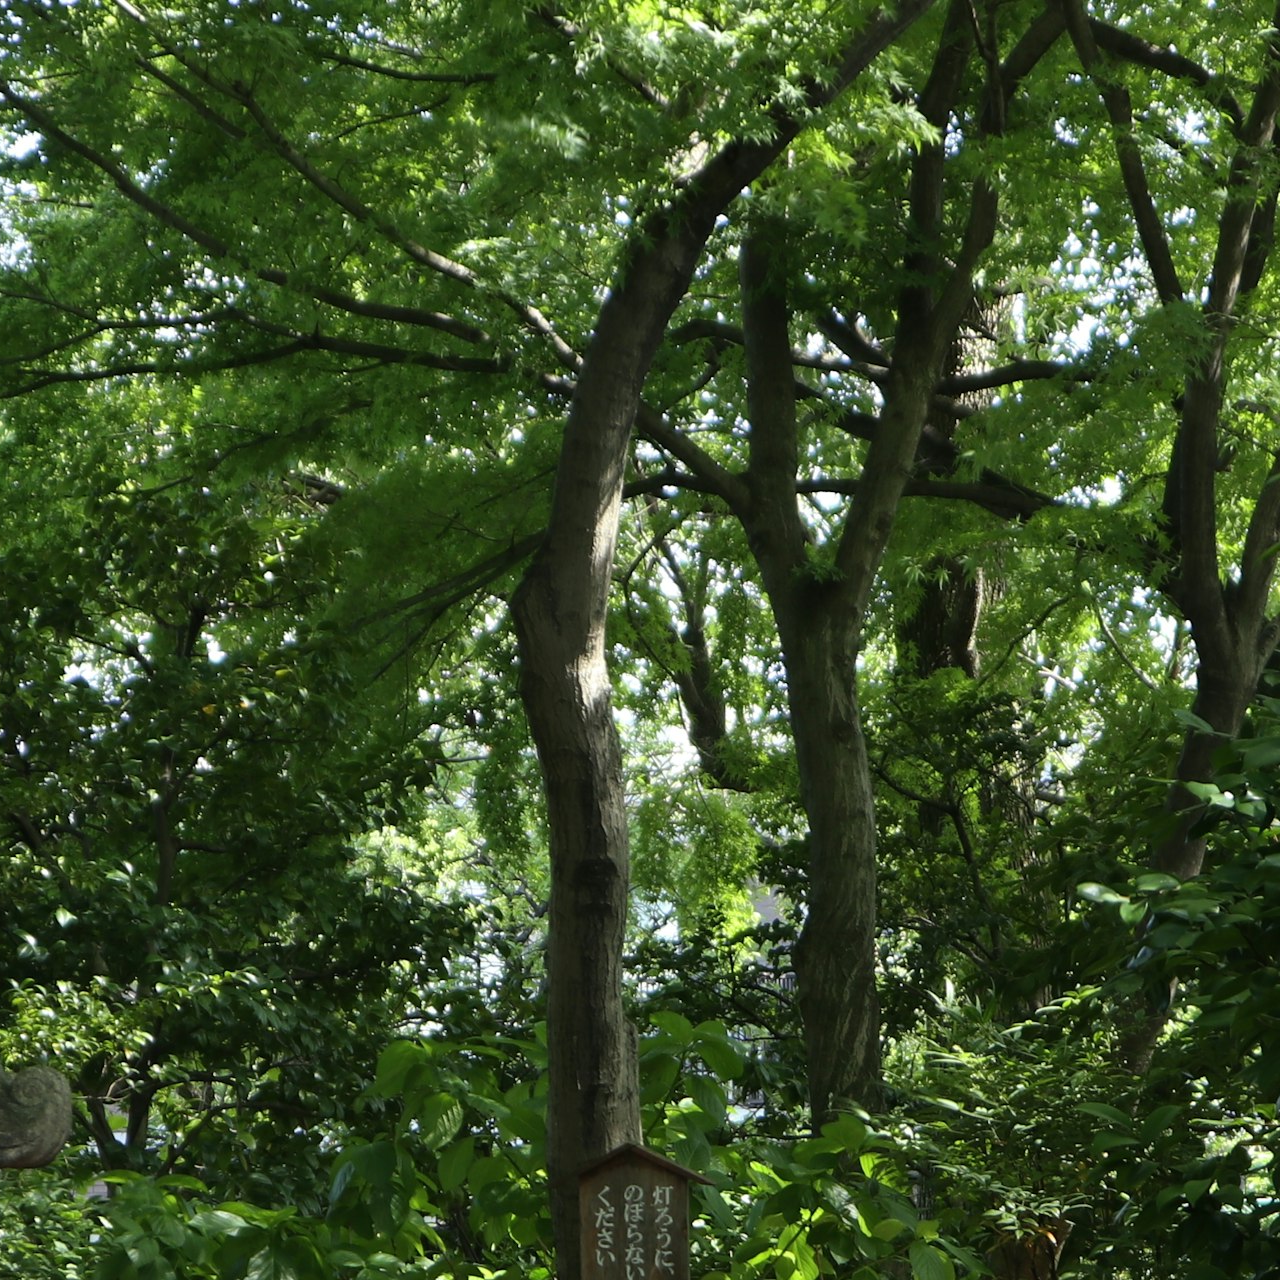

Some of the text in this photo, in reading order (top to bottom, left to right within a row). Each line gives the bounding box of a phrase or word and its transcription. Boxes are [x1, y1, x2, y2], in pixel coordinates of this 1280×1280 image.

[594, 1185, 616, 1267] ください
[652, 1185, 675, 1276] 灯ろうに、
